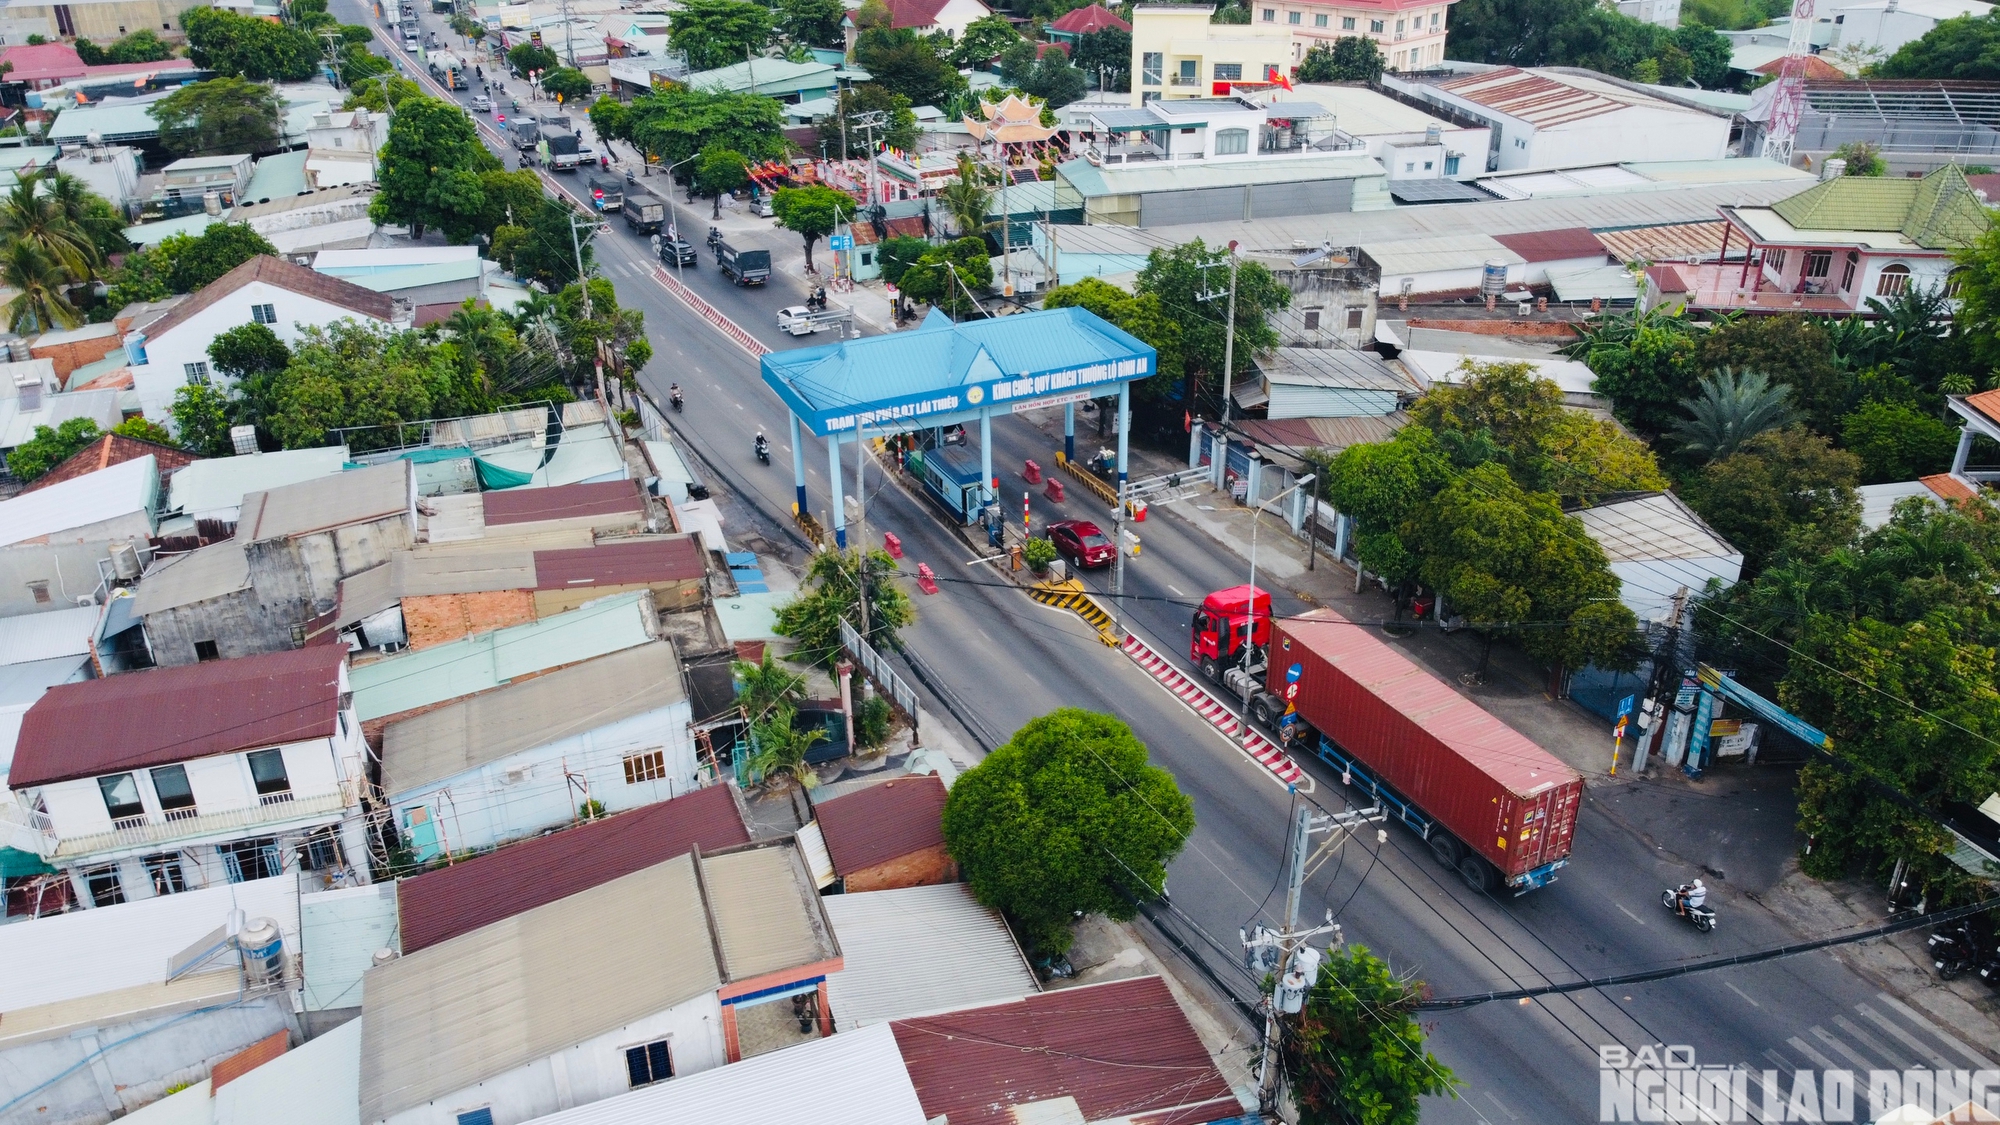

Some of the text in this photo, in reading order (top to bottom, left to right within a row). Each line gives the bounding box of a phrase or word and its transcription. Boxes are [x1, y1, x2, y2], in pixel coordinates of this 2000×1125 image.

[993, 357, 1148, 400] KÍNH CHÚC QUÝ KHÁCH THƯỢNG LỘ BÌNH AN
[825, 414, 855, 431] TRẠM
[875, 405, 892, 422] PHÍ
[915, 399, 932, 415] LÁI
[931, 395, 959, 412] THIÊU
[1057, 396, 1069, 404] ETC
